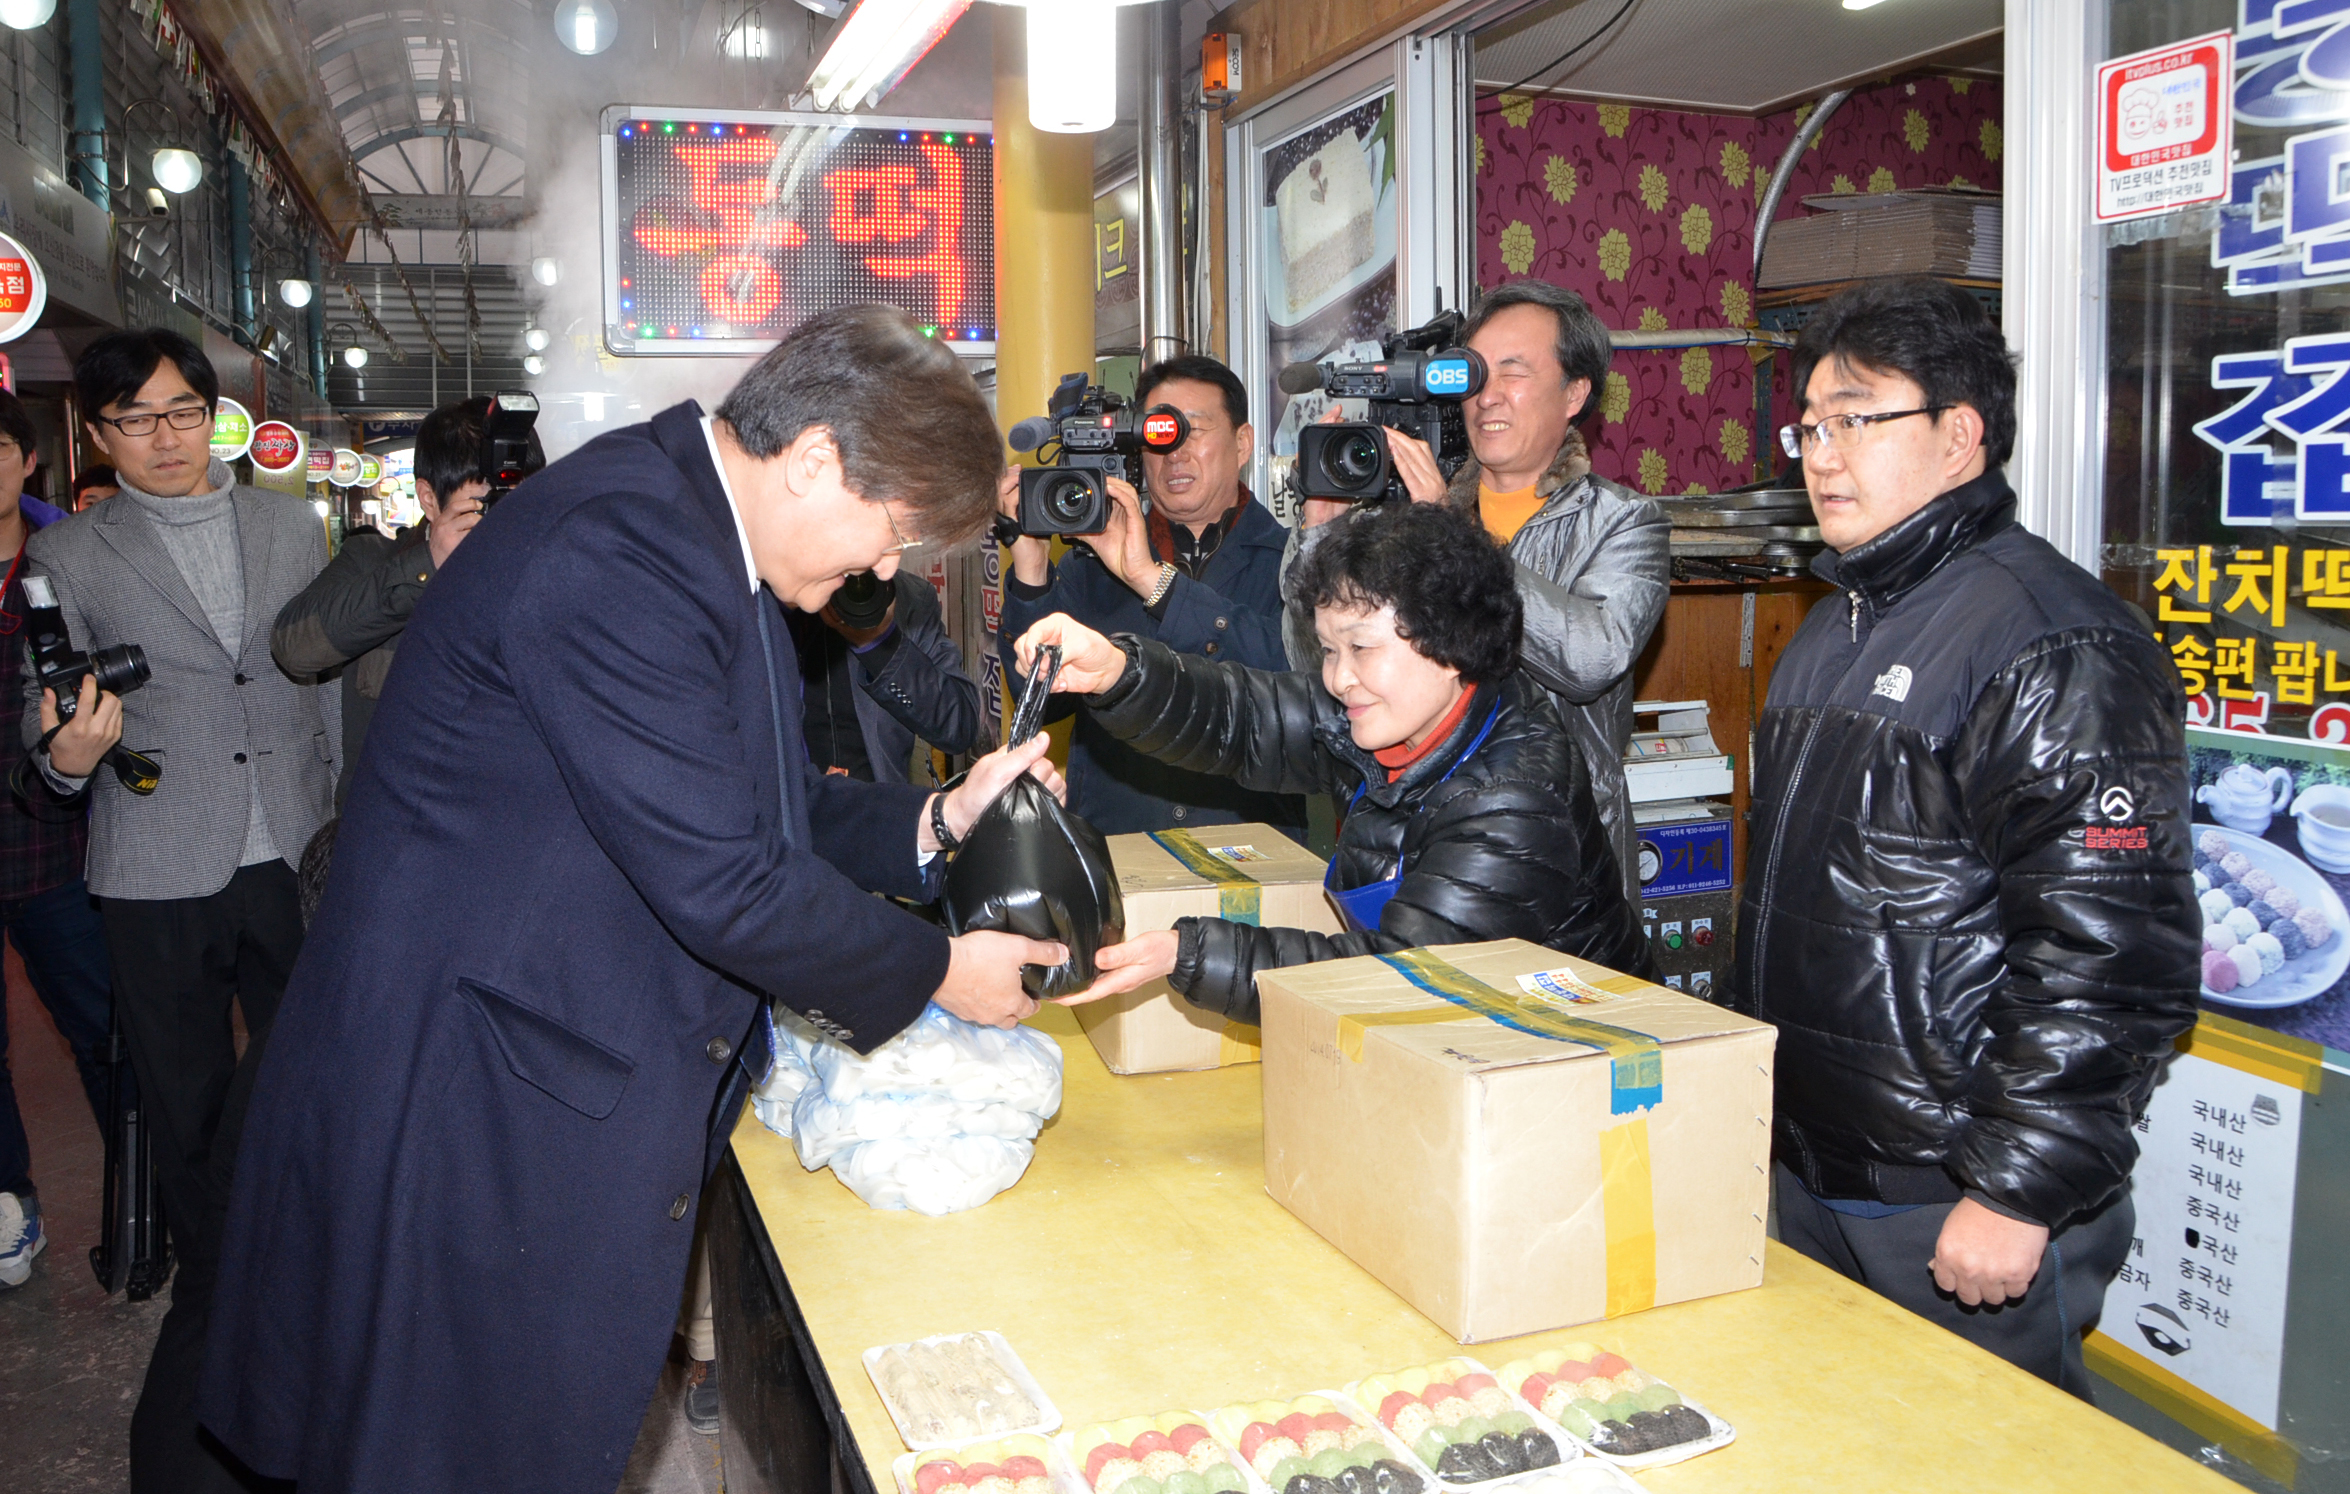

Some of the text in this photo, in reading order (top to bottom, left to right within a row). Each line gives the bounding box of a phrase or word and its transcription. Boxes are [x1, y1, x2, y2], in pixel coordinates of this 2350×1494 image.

[1231, 47, 1239, 76] SECOM
[2173, 114, 2194, 129] 맛집
[2174, 101, 2194, 114] 추천
[2130, 143, 2193, 167] 대한민국맛집
[2110, 159, 2212, 192] TV프로덕션 추천맛집
[0, 276, 25, 294] 점
[1427, 368, 1468, 385] OBS
[1146, 420, 1175, 432] MBC
[2085, 826, 2147, 837] SUMMIT
[2085, 838, 2148, 848] SERIES
[1669, 838, 1723, 874] 기계
[2192, 1099, 2247, 1134] 국내산
[2190, 1131, 2245, 1168] 국내산
[2188, 1163, 2243, 1200] 국내산
[2186, 1196, 2240, 1233] 중국산
[2178, 1257, 2233, 1296] 중국산
[2176, 1288, 2231, 1328] 중국산
